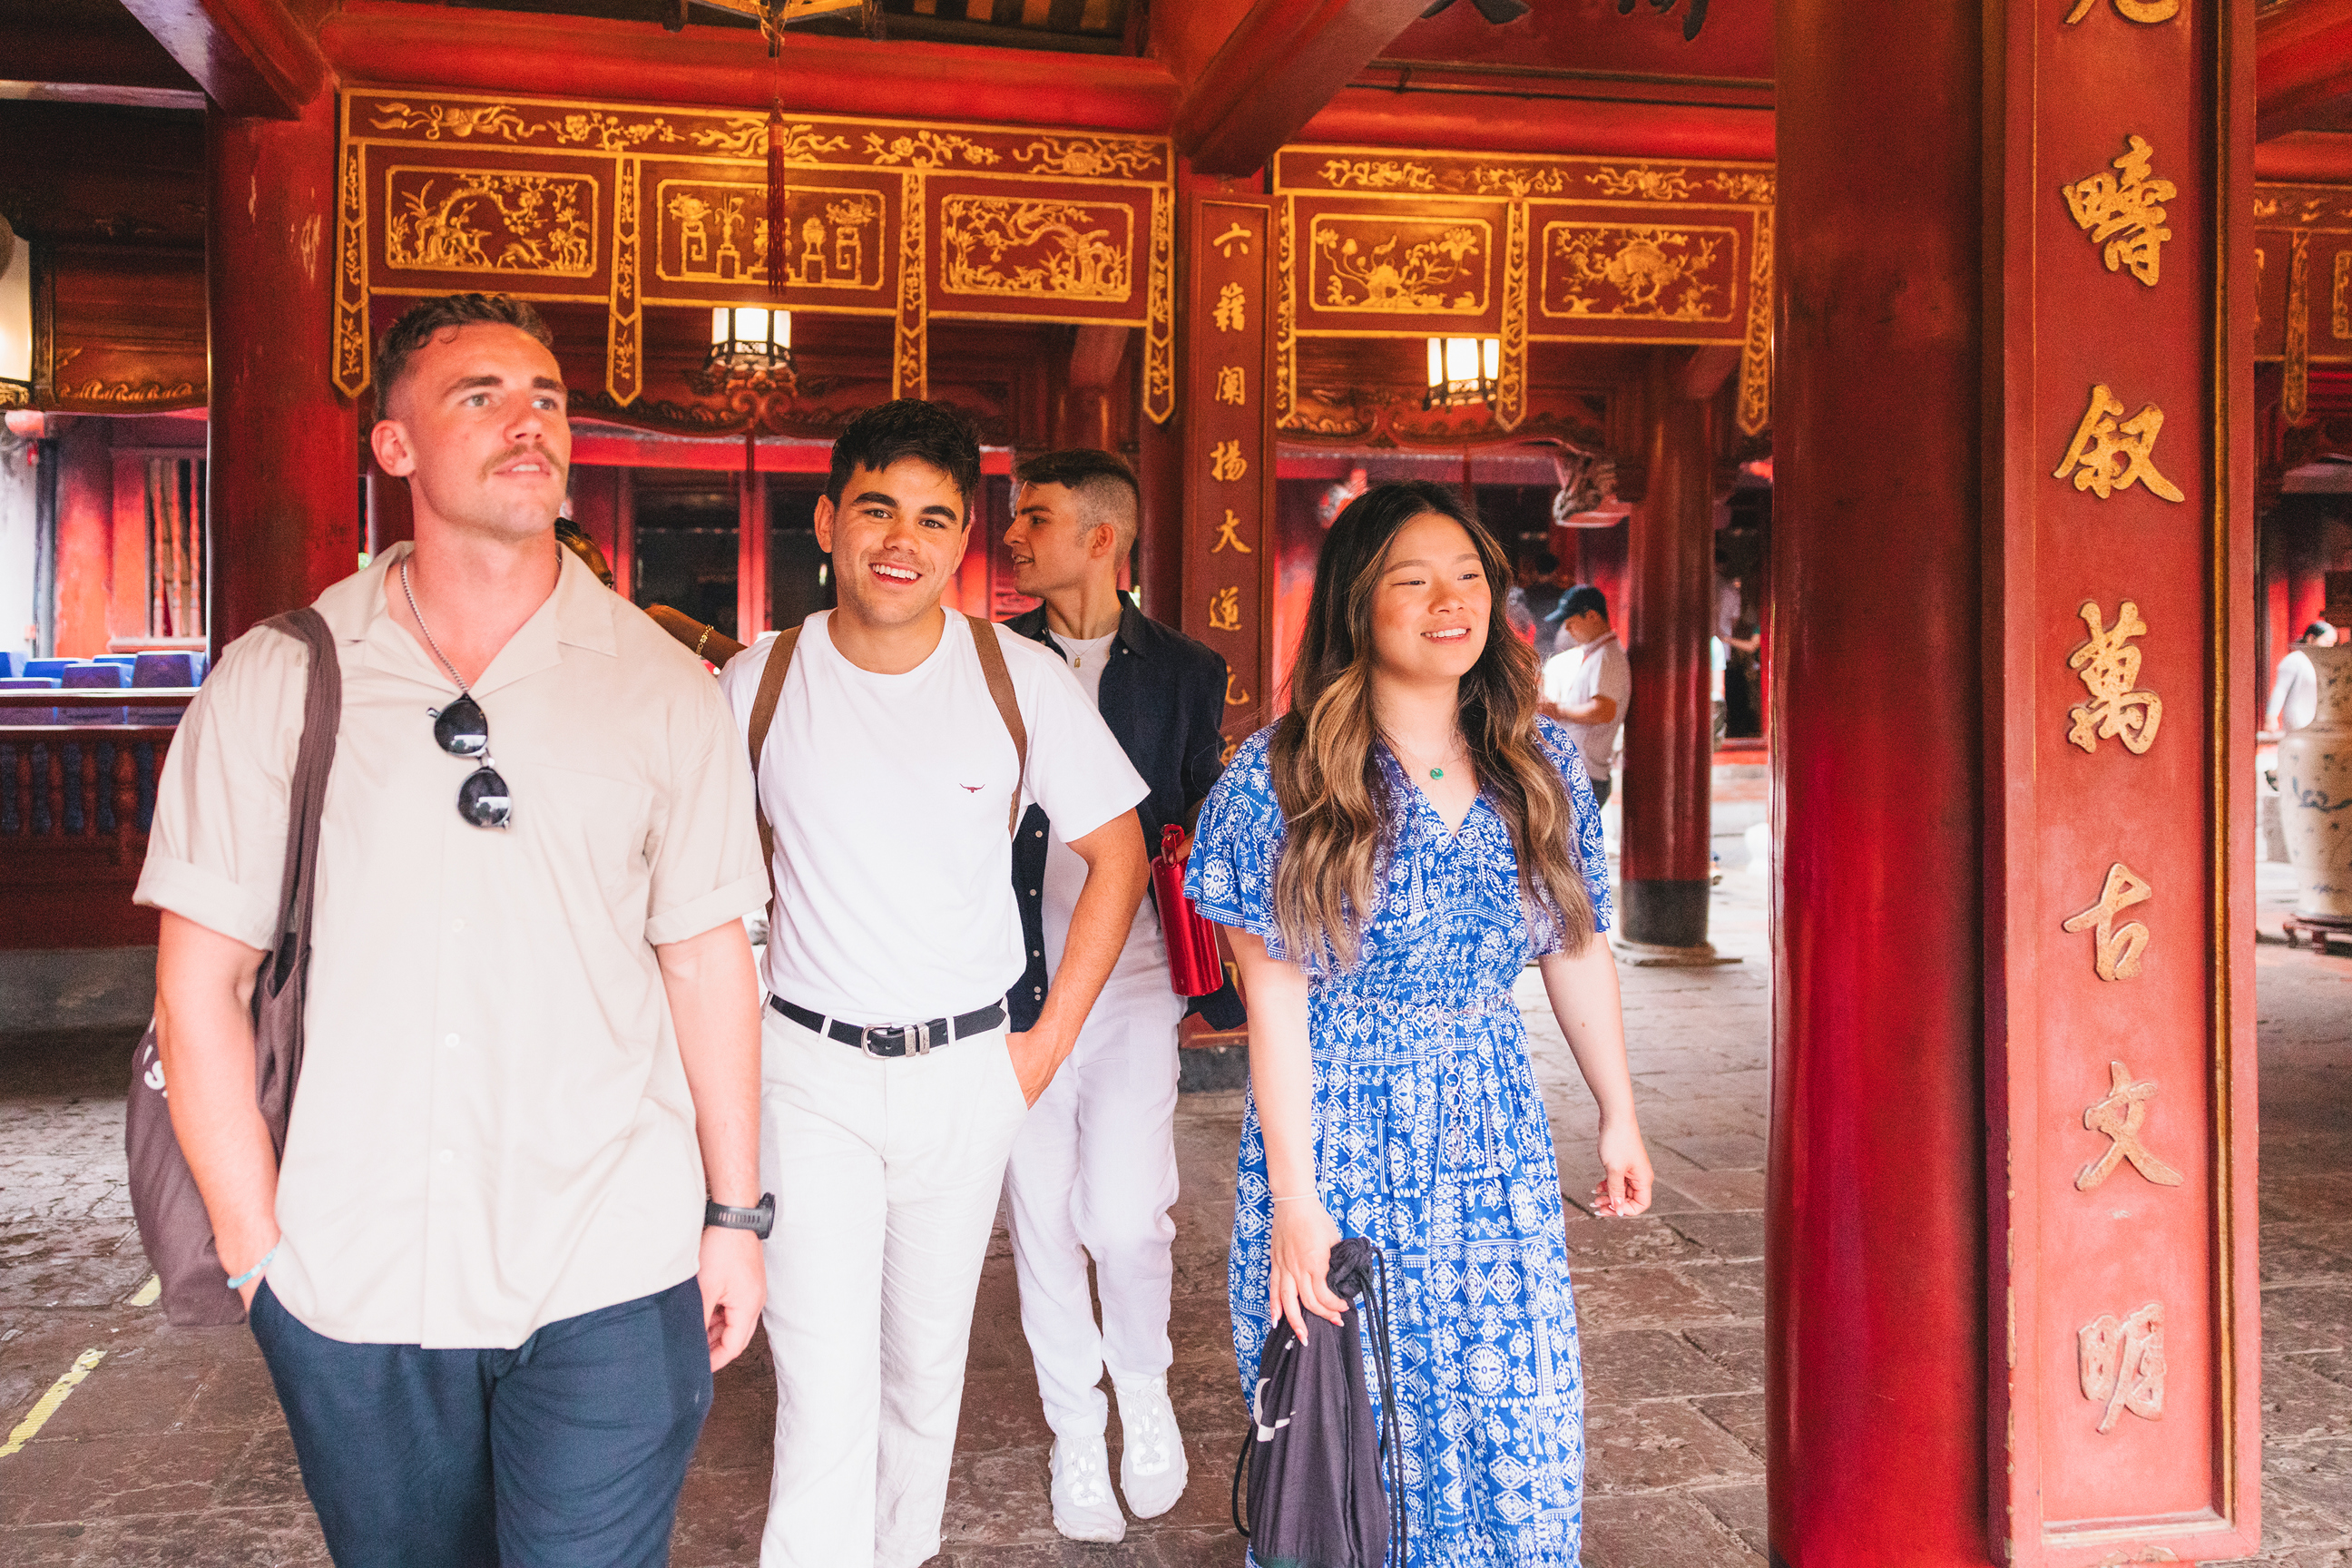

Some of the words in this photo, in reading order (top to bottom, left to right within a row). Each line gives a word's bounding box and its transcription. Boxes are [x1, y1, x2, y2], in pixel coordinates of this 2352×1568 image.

[2053, 0, 2185, 1435] 疇叙萬古文明
